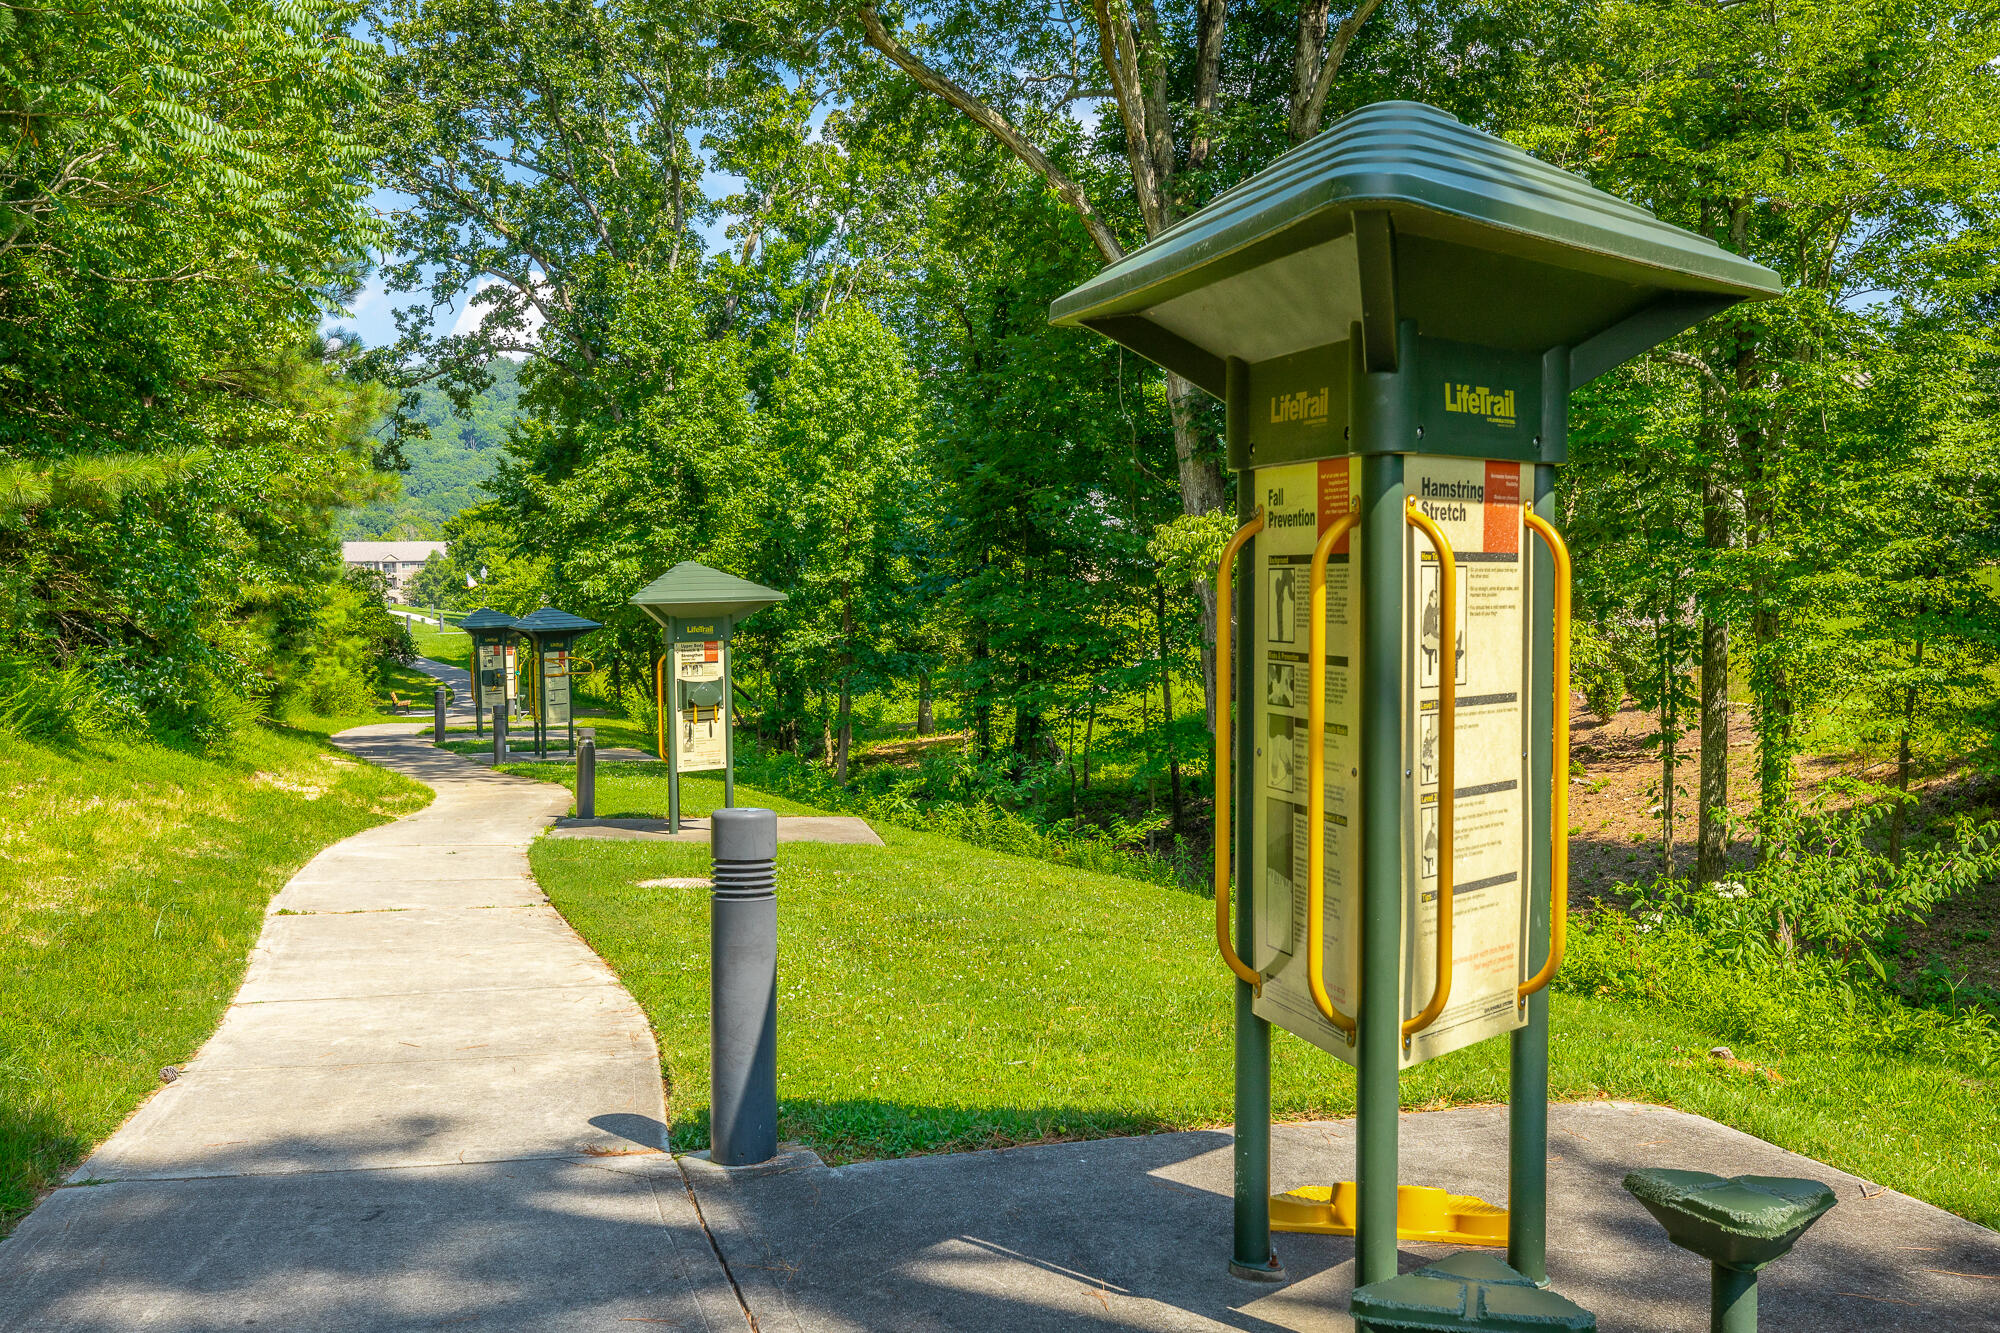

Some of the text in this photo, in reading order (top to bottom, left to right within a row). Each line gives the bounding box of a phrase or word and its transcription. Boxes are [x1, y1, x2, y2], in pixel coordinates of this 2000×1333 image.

[1271, 387, 1328, 423] LifeTrail
[1445, 383, 1515, 417] LifeTrail
[1268, 488, 1284, 507] Fall
[1421, 477, 1484, 504] Hamstring
[1268, 508, 1315, 528] Prevention
[1421, 501, 1466, 521] Stretch
[687, 625, 713, 633] LifeTrail
